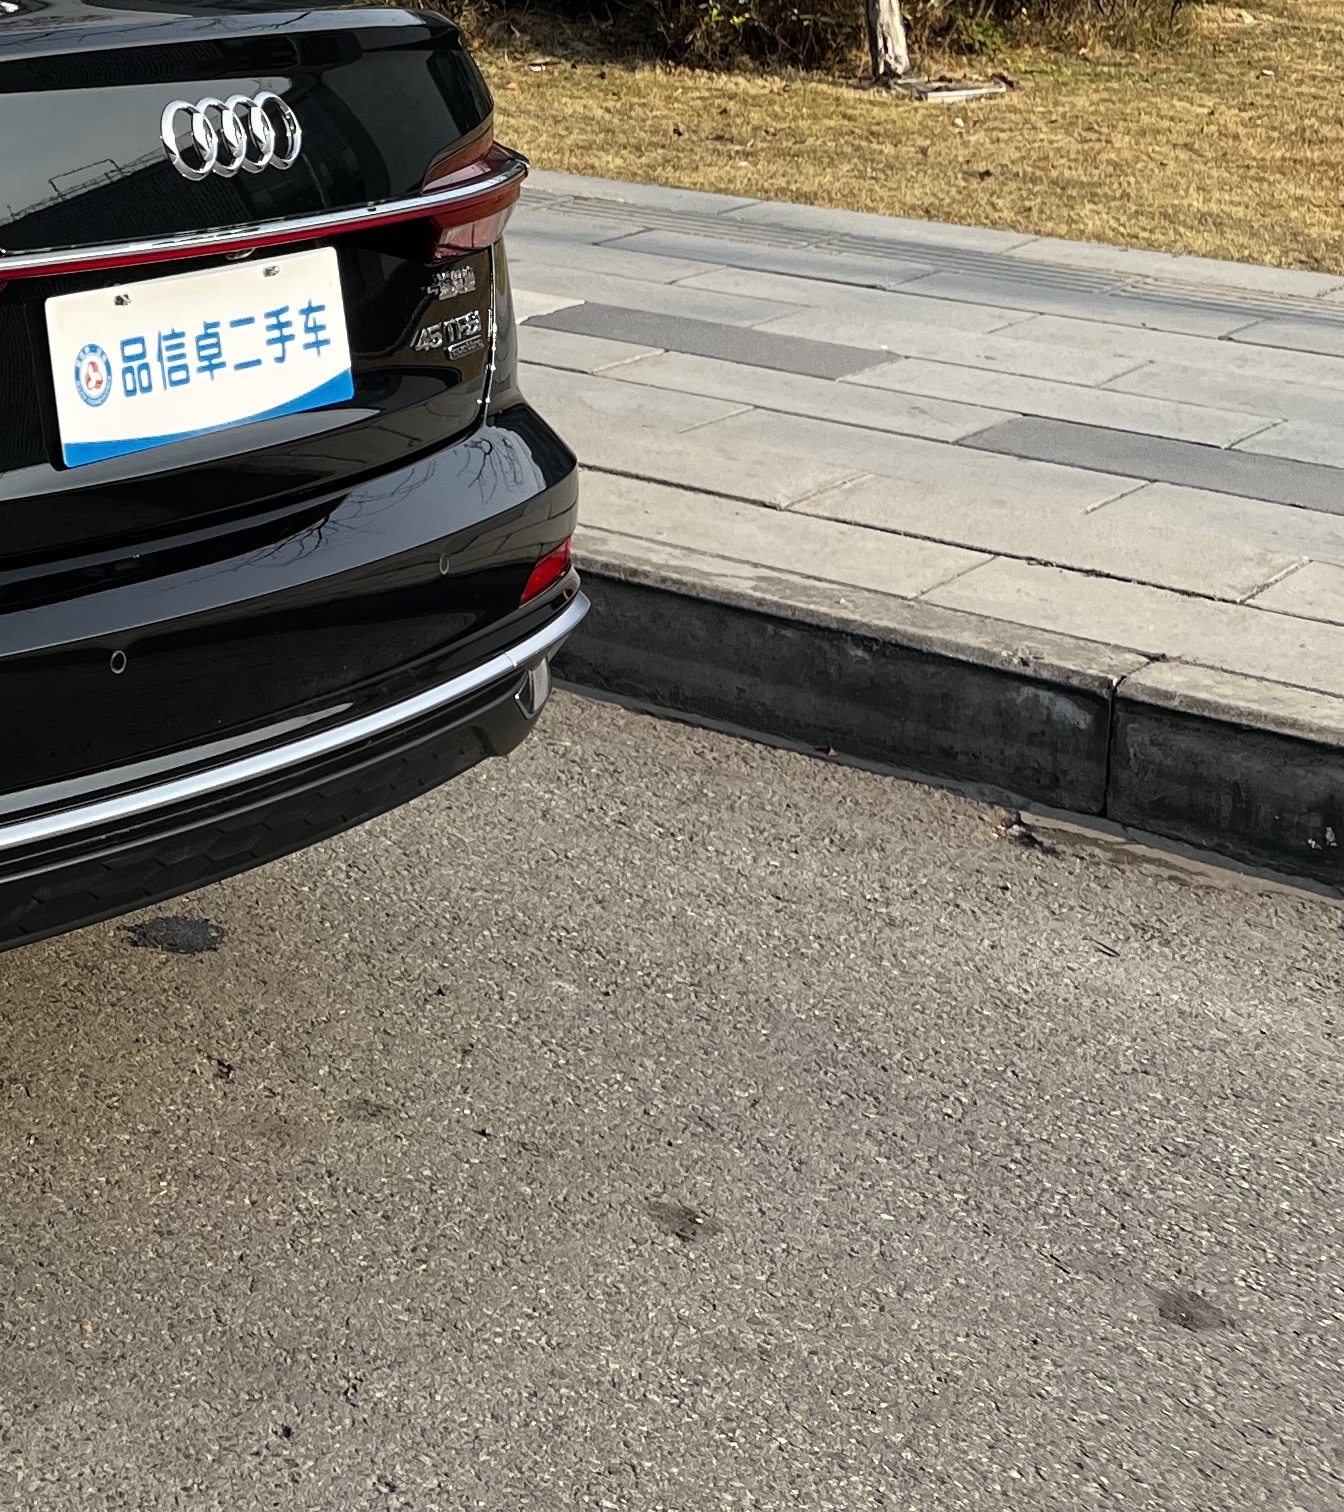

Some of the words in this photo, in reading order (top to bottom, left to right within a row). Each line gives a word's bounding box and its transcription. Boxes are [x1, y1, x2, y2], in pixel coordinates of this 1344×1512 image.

[119, 298, 331, 398] 品信卓二手车
